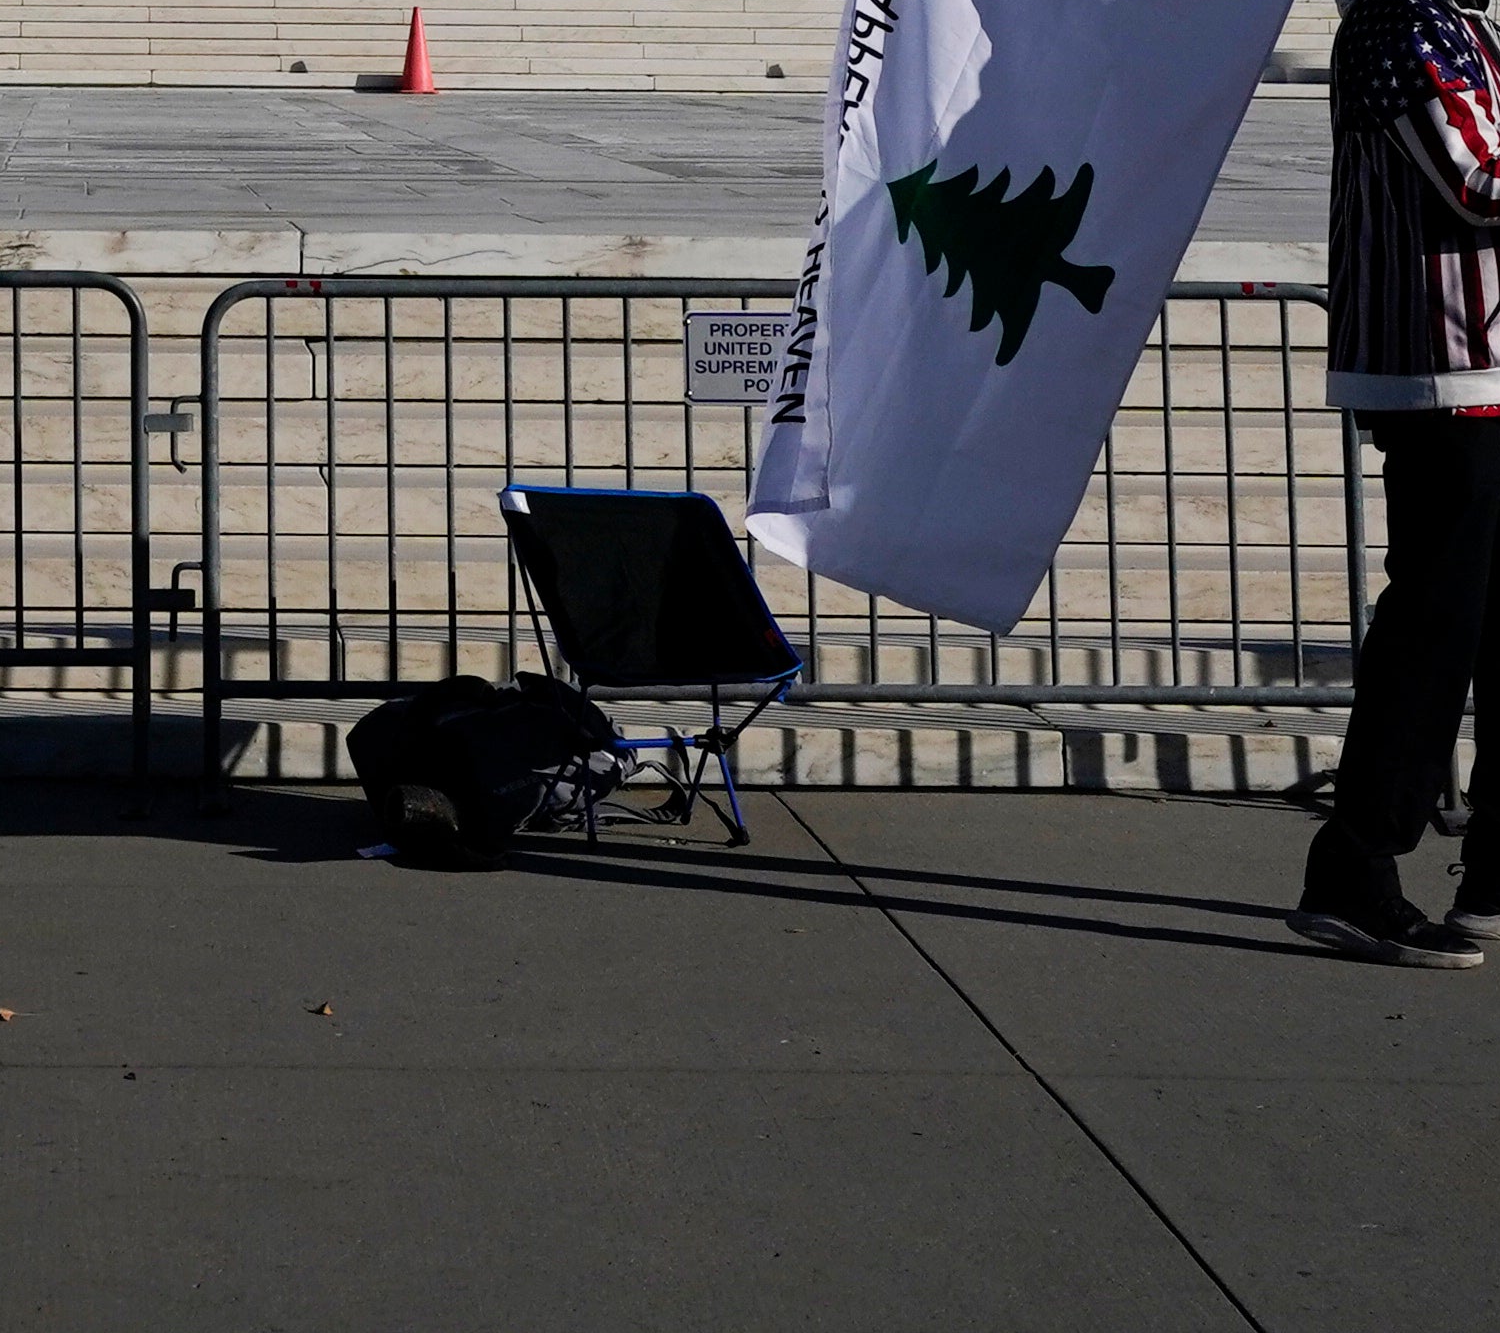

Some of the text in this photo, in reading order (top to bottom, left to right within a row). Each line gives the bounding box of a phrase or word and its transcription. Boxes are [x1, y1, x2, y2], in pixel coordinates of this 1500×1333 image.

[710, 323, 789, 337] PROPER
[704, 342, 772, 355] UNITED
[695, 360, 778, 374] SUPREM
